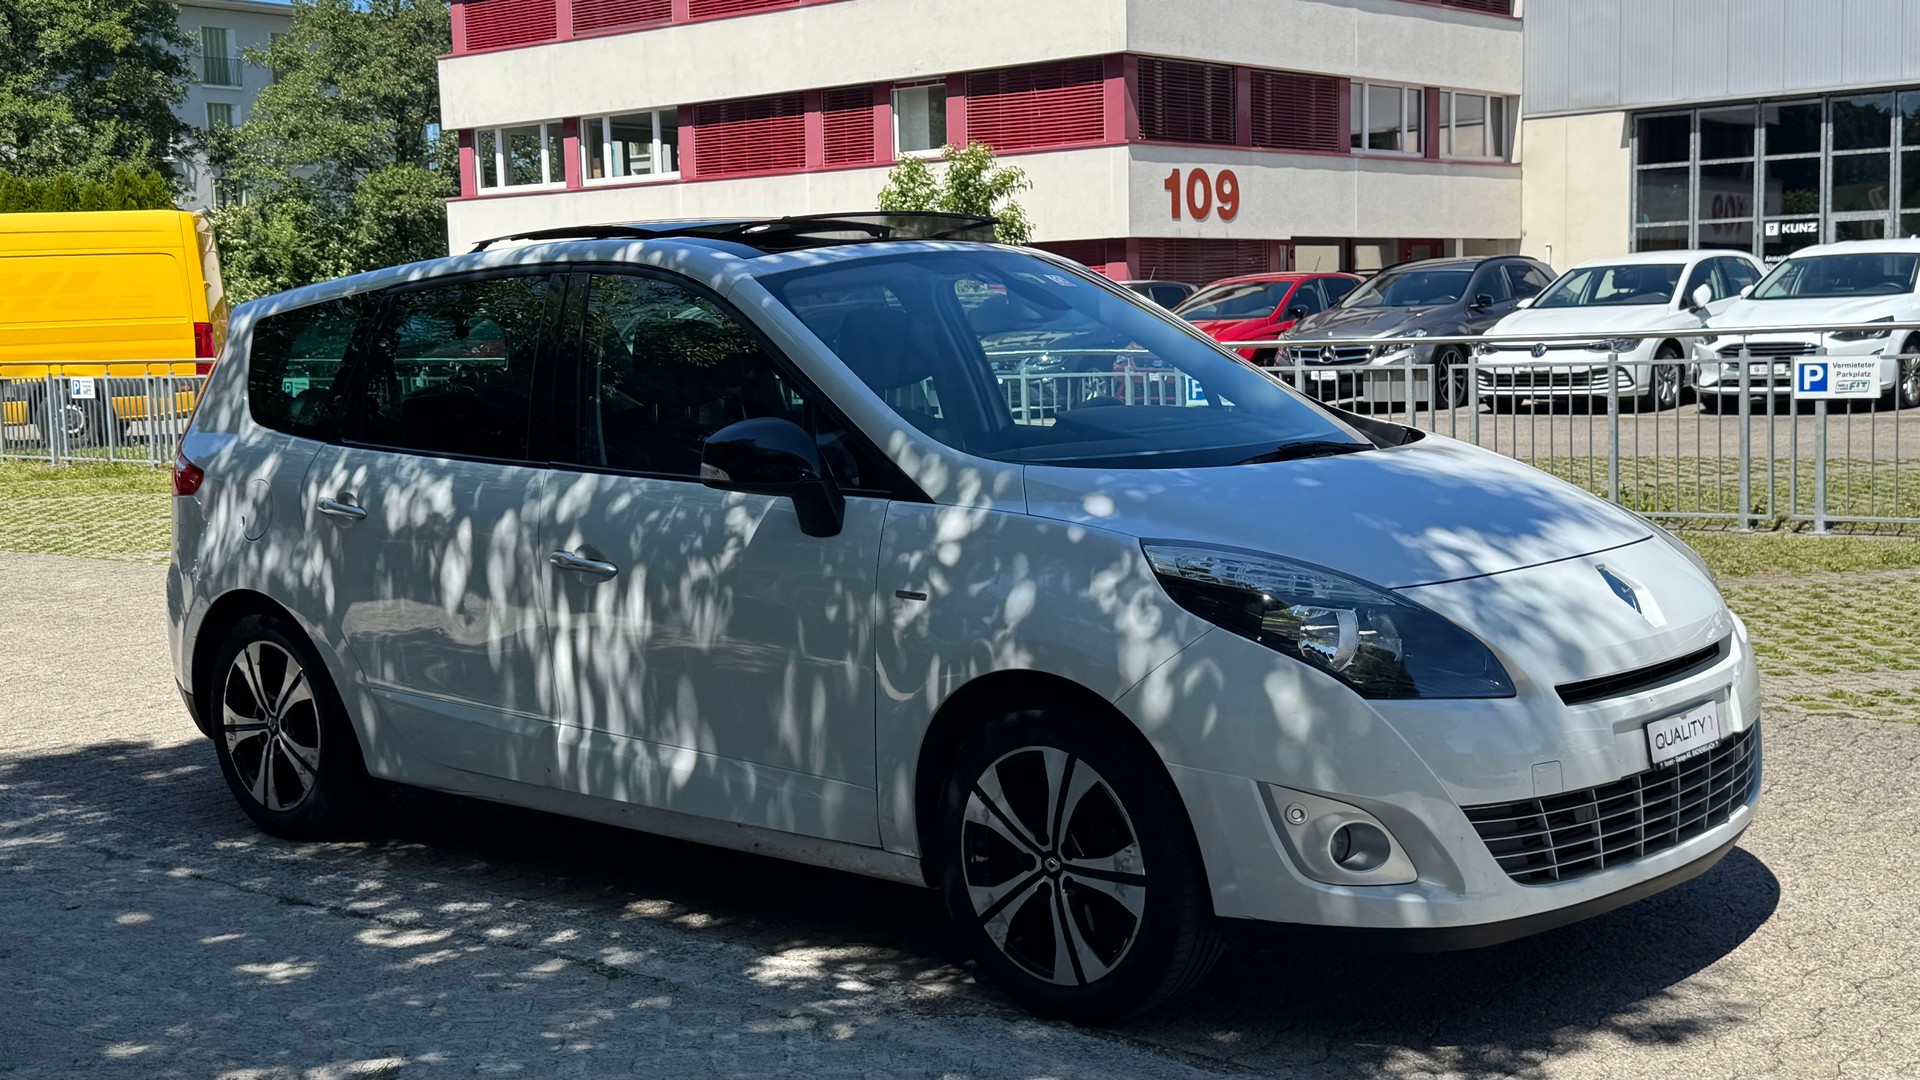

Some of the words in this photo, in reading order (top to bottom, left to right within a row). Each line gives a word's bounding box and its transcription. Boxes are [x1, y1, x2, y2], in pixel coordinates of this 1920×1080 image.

[1164, 168, 1241, 222] 109
[1781, 222, 1818, 234] KUNZ
[1804, 365, 1823, 390] P
[1655, 717, 1705, 750] QUALITY
